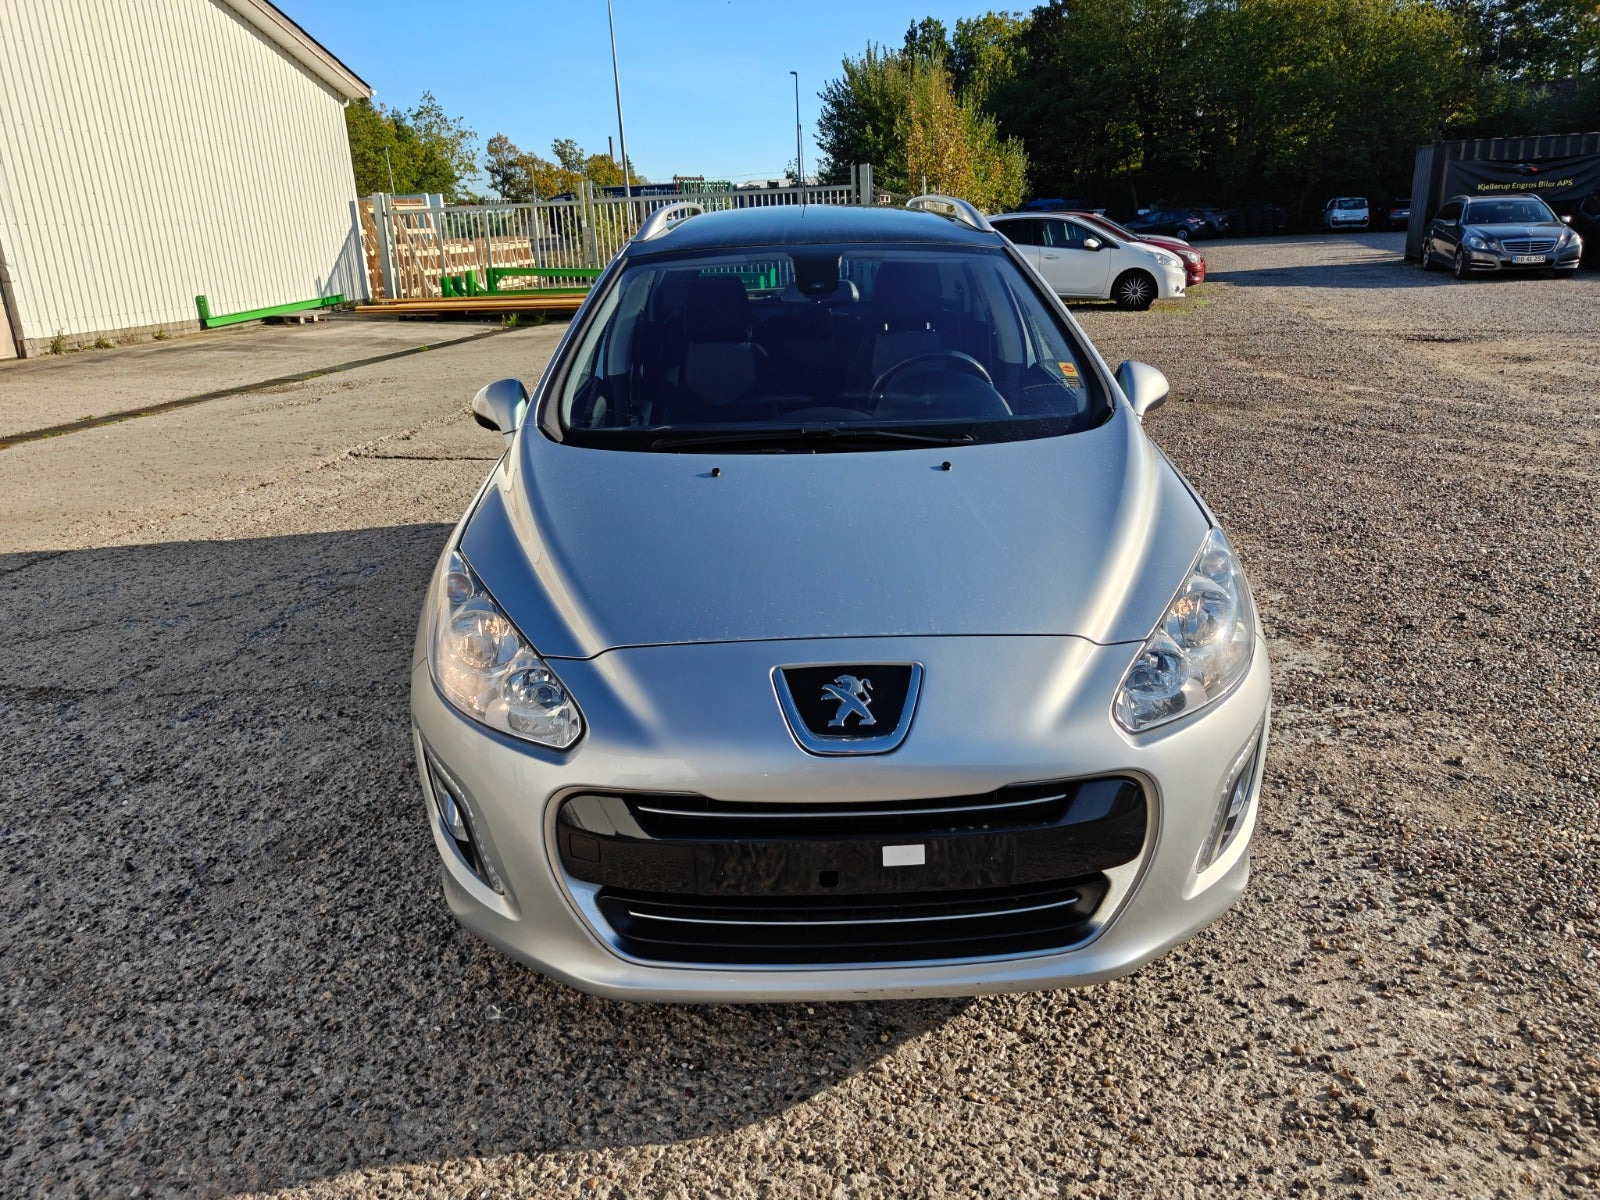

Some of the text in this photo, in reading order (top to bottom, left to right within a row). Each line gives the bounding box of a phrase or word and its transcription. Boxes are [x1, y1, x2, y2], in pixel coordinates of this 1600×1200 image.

[1477, 183, 1511, 191] Kjellerup
[1511, 182, 1537, 190] Engros
[1557, 179, 1573, 187] APS
